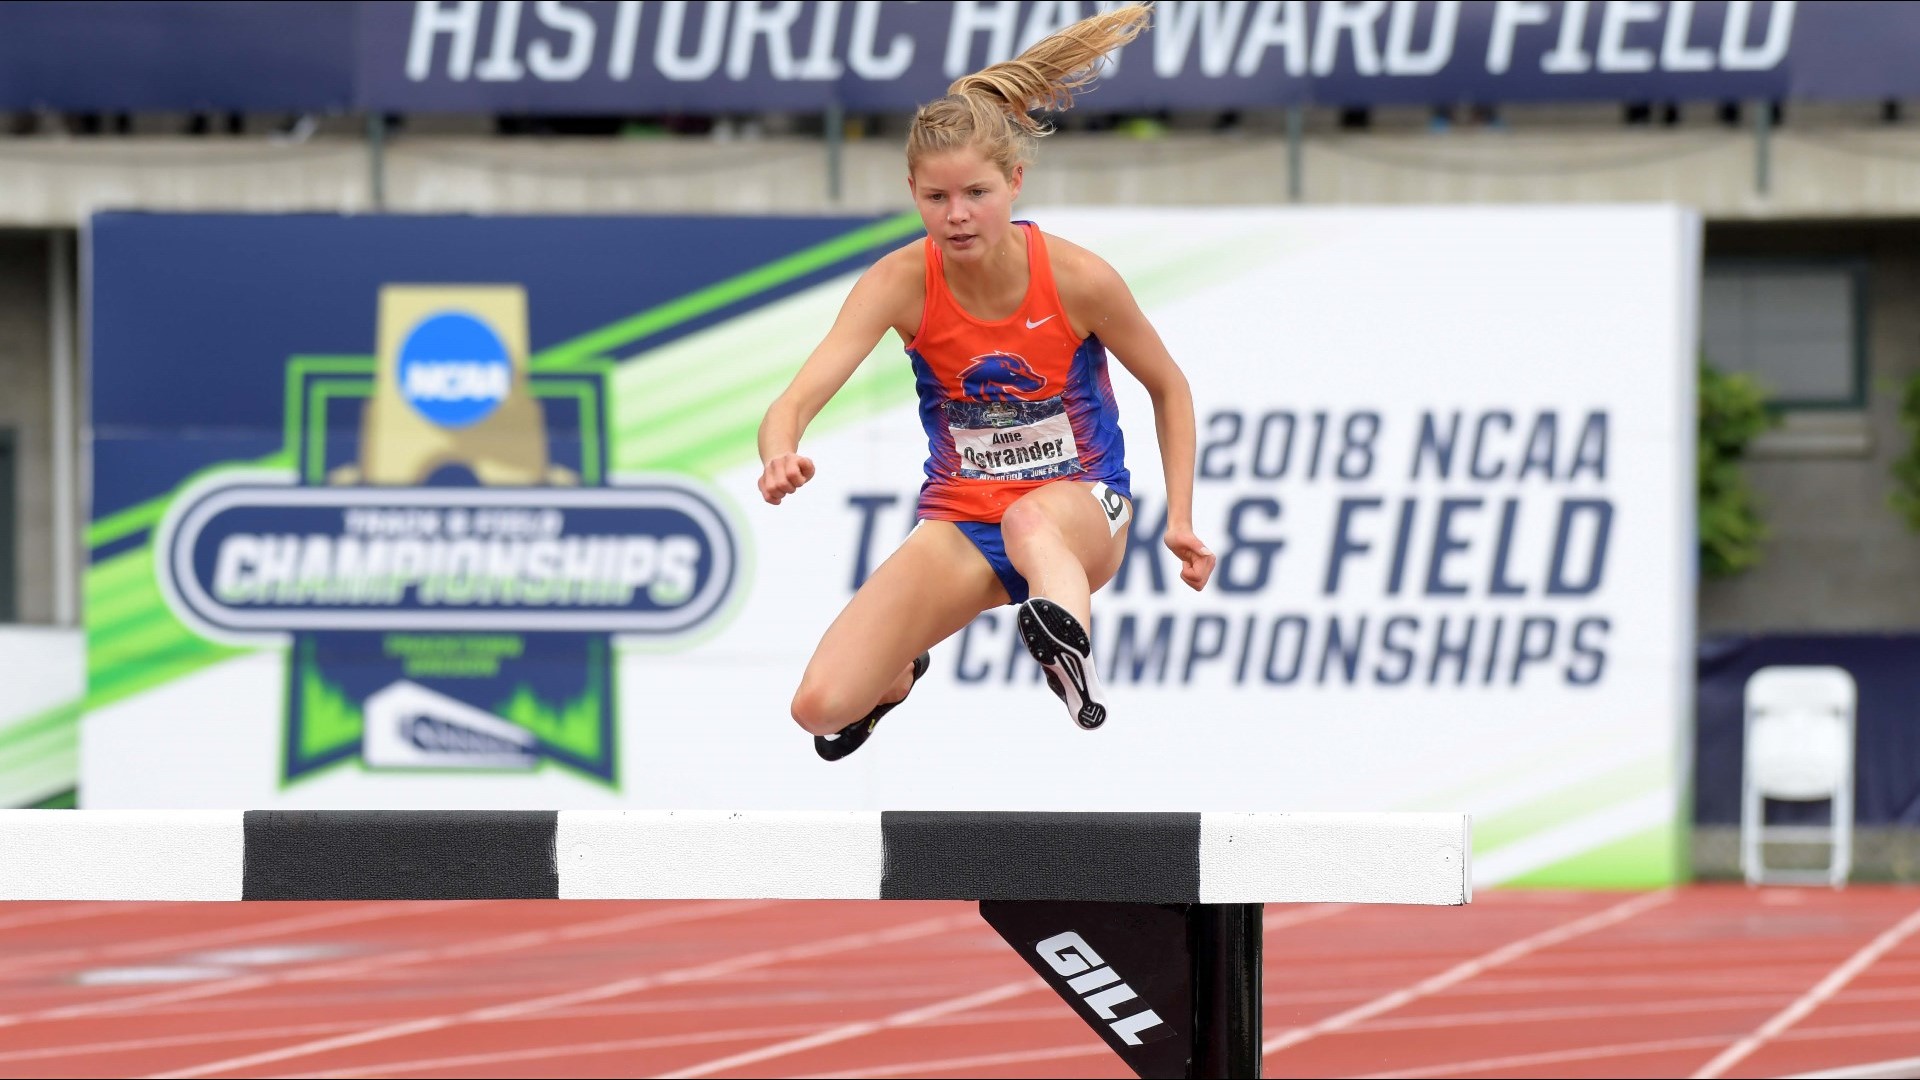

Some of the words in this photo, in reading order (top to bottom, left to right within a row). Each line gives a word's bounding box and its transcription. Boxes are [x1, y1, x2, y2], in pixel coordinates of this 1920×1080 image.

[404, 1, 915, 82] HISTORIC
[1485, 1, 1799, 76] FIELD
[405, 360, 512, 401] NCAA
[963, 438, 1063, 469] Ostrander
[992, 432, 1023, 445] Allie
[1031, 468, 1047, 478] JUNE
[1198, 409, 1383, 483] 2018
[1409, 409, 1610, 483] NCAA
[212, 534, 701, 607] CHAMPIONSHIPS
[1214, 496, 1289, 595] &
[1323, 496, 1616, 595] FIELD
[954, 613, 1612, 688] CHMPIONSHIPS
[1036, 931, 1164, 1046] GILL
